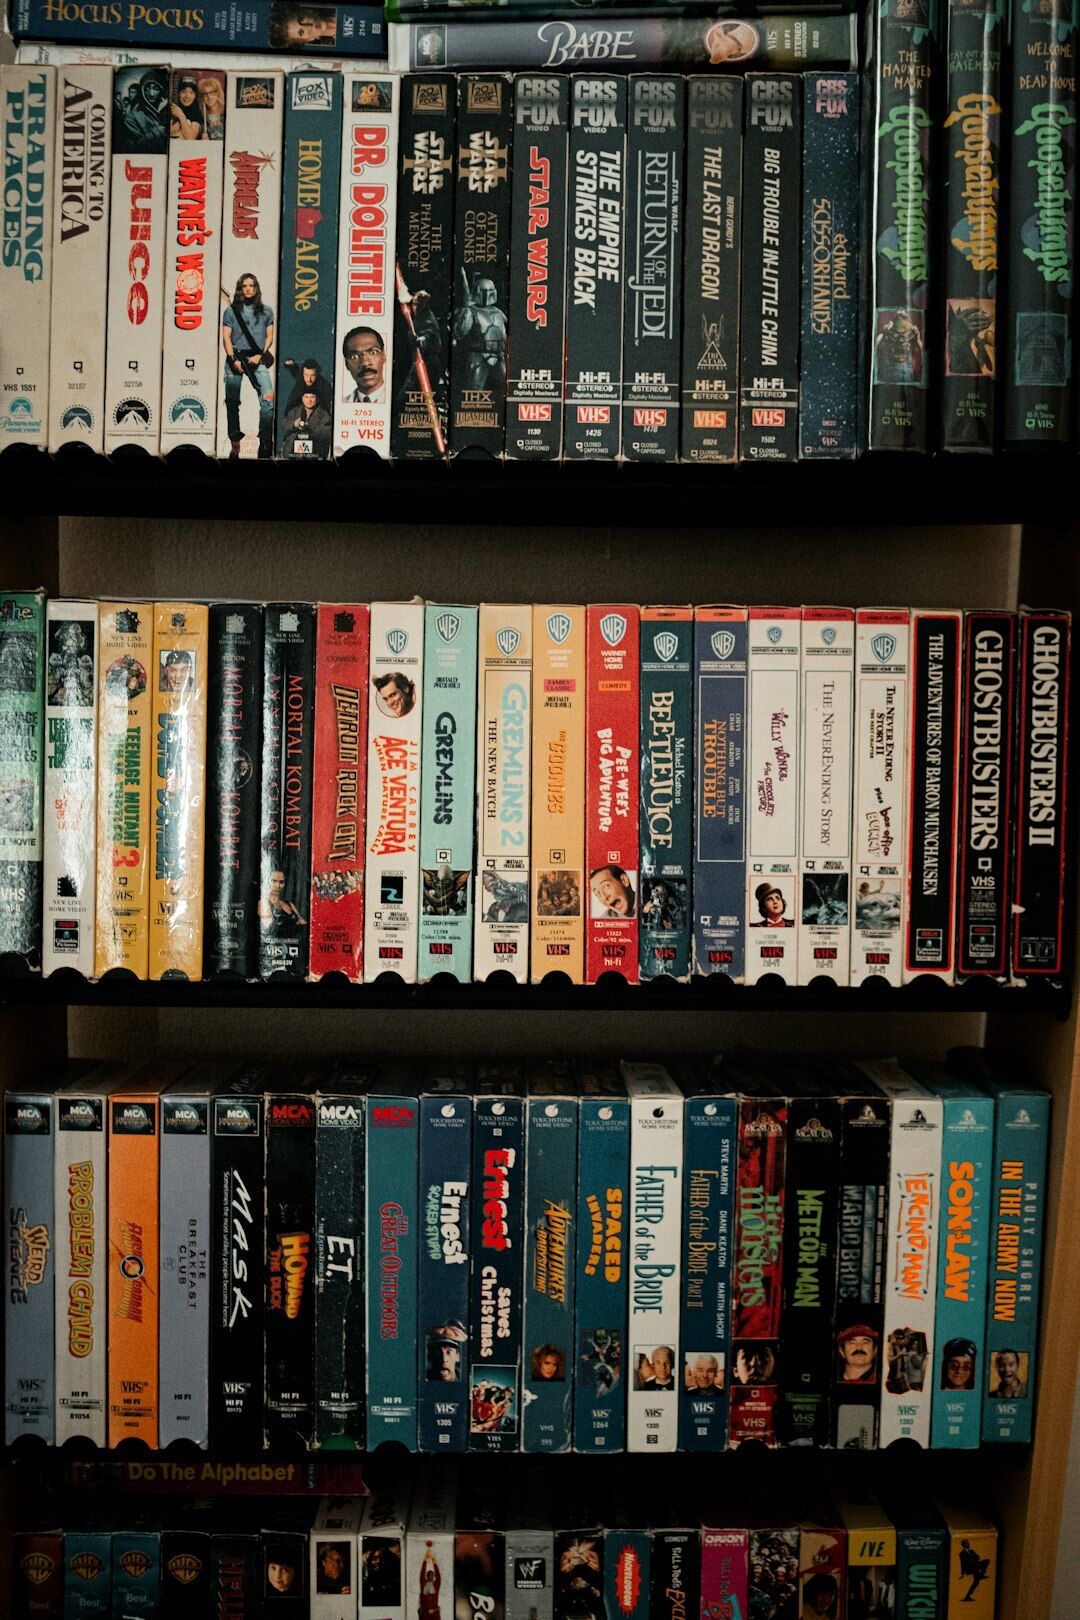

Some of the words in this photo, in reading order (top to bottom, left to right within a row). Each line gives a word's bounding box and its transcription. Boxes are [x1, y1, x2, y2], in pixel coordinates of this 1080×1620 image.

[41, 0, 122, 27] HOCUS
[128, 3, 204, 30] POCUS
[538, 20, 637, 67] BABE
[61, 79, 92, 243] AMERICA
[89, 104, 105, 187] COMING
[352, 126, 385, 174] DR.
[598, 150, 619, 193] THE
[703, 147, 720, 178] THE
[764, 148, 779, 174] BIG
[3, 90, 24, 268] PLACES
[24, 74, 46, 283] TRADING
[230, 151, 261, 239] AIRHEADS
[297, 140, 321, 207] HOME
[529, 146, 549, 234] STAR
[575, 150, 596, 242] STRIKES
[703, 180, 720, 218] LAST
[879, 107, 932, 281] Goosebumps
[944, 94, 1003, 271] Goosebumps
[1015, 103, 1075, 283] Goosebumps
[89, 193, 103, 221] TO
[177, 158, 212, 245] WAYNE'S
[643, 152, 668, 261] RETURN
[763, 178, 779, 245] TROUBLE
[349, 186, 384, 316] DOLITTLE
[408, 212, 419, 268] MENACE
[418, 203, 430, 273] PHANTOM
[431, 224, 442, 251] THE
[463, 210, 475, 263] CLONES
[485, 211, 497, 263] ATTACK
[598, 199, 618, 283] EMPIRE
[701, 223, 718, 299] DRAGON
[527, 239, 548, 327] WARS
[573, 247, 595, 306] BACK
[762, 268, 778, 316] LITTLE
[812, 198, 831, 334] SCISSORHANDS
[833, 234, 850, 299] edward
[628, 276, 666, 338] JEDI
[761, 319, 777, 365] CHINA
[928, 634, 944, 660] THE
[287, 675, 303, 759] MORTAL
[822, 681, 834, 709] THE
[886, 686, 895, 705] THE
[926, 663, 943, 746] ADVENTURES
[331, 684, 358, 763] DETROIT
[487, 719, 496, 743] THE
[598, 728, 611, 755] BIG
[771, 711, 785, 744] WILLY
[886, 707, 894, 740] NEVER
[970, 630, 1002, 850] GHOSTBUSTERS
[1029, 626, 1059, 822] GHOSTBUSTERS
[125, 727, 140, 783] TEENAGE
[380, 736, 406, 770] ACE
[409, 741, 417, 771] JIM
[487, 747, 496, 774] NEW
[648, 691, 674, 848] BEETLEJUICE
[703, 720, 716, 818] TROUBLE
[716, 720, 726, 782] NOTHING
[885, 742, 893, 782] ENDING
[926, 748, 940, 764] OF
[336, 770, 357, 816] ROCK
[487, 778, 496, 818] BATCH
[597, 758, 612, 832] ADVENTURE
[615, 745, 631, 816] PEE-WEE'S
[715, 790, 725, 818] BUT
[758, 780, 766, 812] FACTORY
[765, 777, 773, 817] CHOCOLATE
[924, 767, 938, 809] BARON
[124, 793, 139, 848] MUTANT
[285, 765, 301, 850] KOMBAT
[377, 775, 406, 855] VENTURA
[408, 788, 416, 853] CARREY
[820, 809, 832, 847] STORY
[327, 821, 357, 863] CITY
[501, 829, 523, 846] 2
[922, 811, 937, 896] MUNCHAUSEN
[1029, 827, 1054, 846] II
[221, 1172, 230, 1205] Sometimes
[635, 1166, 676, 1222] FATHER
[689, 1169, 717, 1207] FATHER
[1000, 1161, 1023, 1179] IN
[68, 1160, 94, 1276] PROBLEM
[222, 1218, 230, 1232] most
[440, 1181, 467, 1264] Ernest
[483, 1148, 515, 1251] Ernest
[690, 1210, 707, 1220] of
[719, 1210, 727, 1233] DIANE
[841, 1186, 862, 1246] MARIO
[905, 1179, 929, 1250] ENCINO
[1000, 1187, 1022, 1215] THE
[1024, 1183, 1036, 1235] PAULY
[221, 1234, 230, 1256] unlikely
[230, 1170, 252, 1327] MASK
[380, 1203, 402, 1254] GREAT
[544, 1199, 571, 1302] ADVENTURES
[584, 1195, 602, 1276] INVADERS
[605, 1187, 622, 1283] SPACED
[634, 1244, 654, 1260] the
[635, 1227, 655, 1238] of
[689, 1223, 707, 1238] the
[718, 1236, 726, 1267] KEATON
[737, 1186, 766, 1307] monsters
[796, 1190, 826, 1264] METEOR
[996, 1222, 1019, 1273] ARMY
[10, 1207, 27, 1304] SCIENCE
[28, 1229, 46, 1283] WEIRD
[221, 1258, 230, 1278] people
[270, 1250, 281, 1273] THE
[282, 1234, 309, 1318] HOWARD
[325, 1236, 354, 1281] E.T.
[535, 1229, 546, 1292] BABYSITTING
[688, 1241, 716, 1273] BRIDE
[838, 1249, 858, 1303] BROS.
[903, 1253, 926, 1295] MAN
[1019, 1249, 1033, 1303] SHORE
[221, 1280, 230, 1304] become
[270, 1276, 282, 1310] DUCK
[381, 1257, 400, 1340] OUTDOORS
[480, 1266, 495, 1357] Christmas
[496, 1287, 510, 1338] saves
[634, 1264, 674, 1314] BRIDE
[688, 1279, 700, 1298] PART
[717, 1282, 725, 1310] MARTIN
[792, 1268, 820, 1307] MAN
[993, 1279, 1016, 1322] NOW
[68, 1280, 93, 1358] CHILD
[716, 1312, 724, 1339] SHORT
[129, 1463, 154, 1480] Do
[160, 1463, 195, 1479] The
[201, 1463, 295, 1486] Alphabet
[623, 1553, 634, 1606] NICKELODEON
